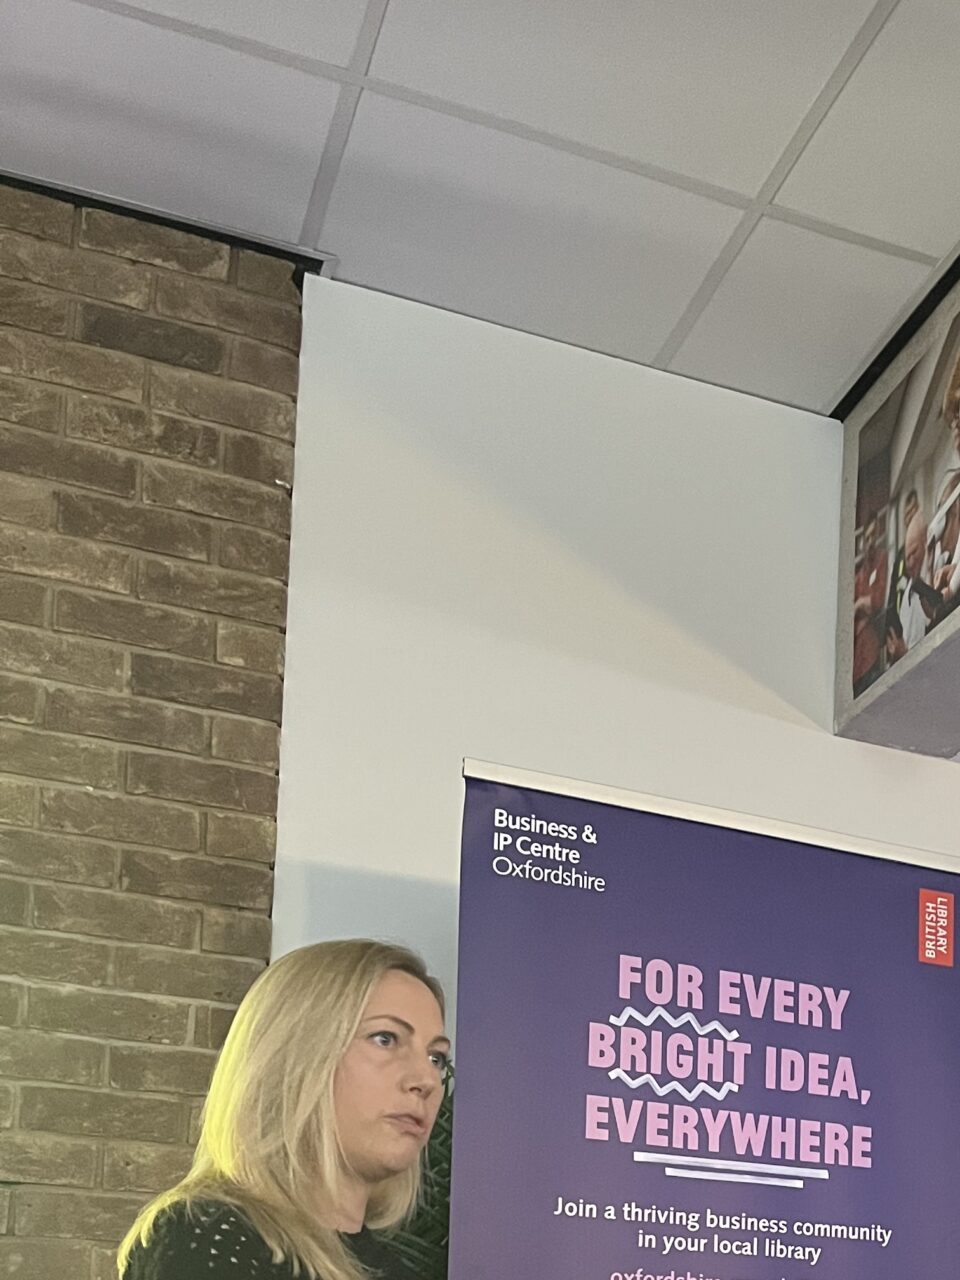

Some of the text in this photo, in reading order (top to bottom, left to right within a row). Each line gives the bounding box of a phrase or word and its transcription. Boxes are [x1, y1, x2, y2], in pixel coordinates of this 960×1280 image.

[493, 832, 581, 864] IP Centre
[494, 808, 598, 845] Business &
[492, 856, 606, 892] Oxfordshire
[925, 902, 937, 959] BRITISH
[936, 896, 948, 955] LIBRARY
[618, 954, 850, 1030] FOR EVERY
[588, 1021, 871, 1105] BRIGHT IDEA,
[585, 1094, 873, 1168] EVERYWHERE
[553, 1197, 893, 1247] Join a thriving business community
[638, 1229, 822, 1266] in your local library
